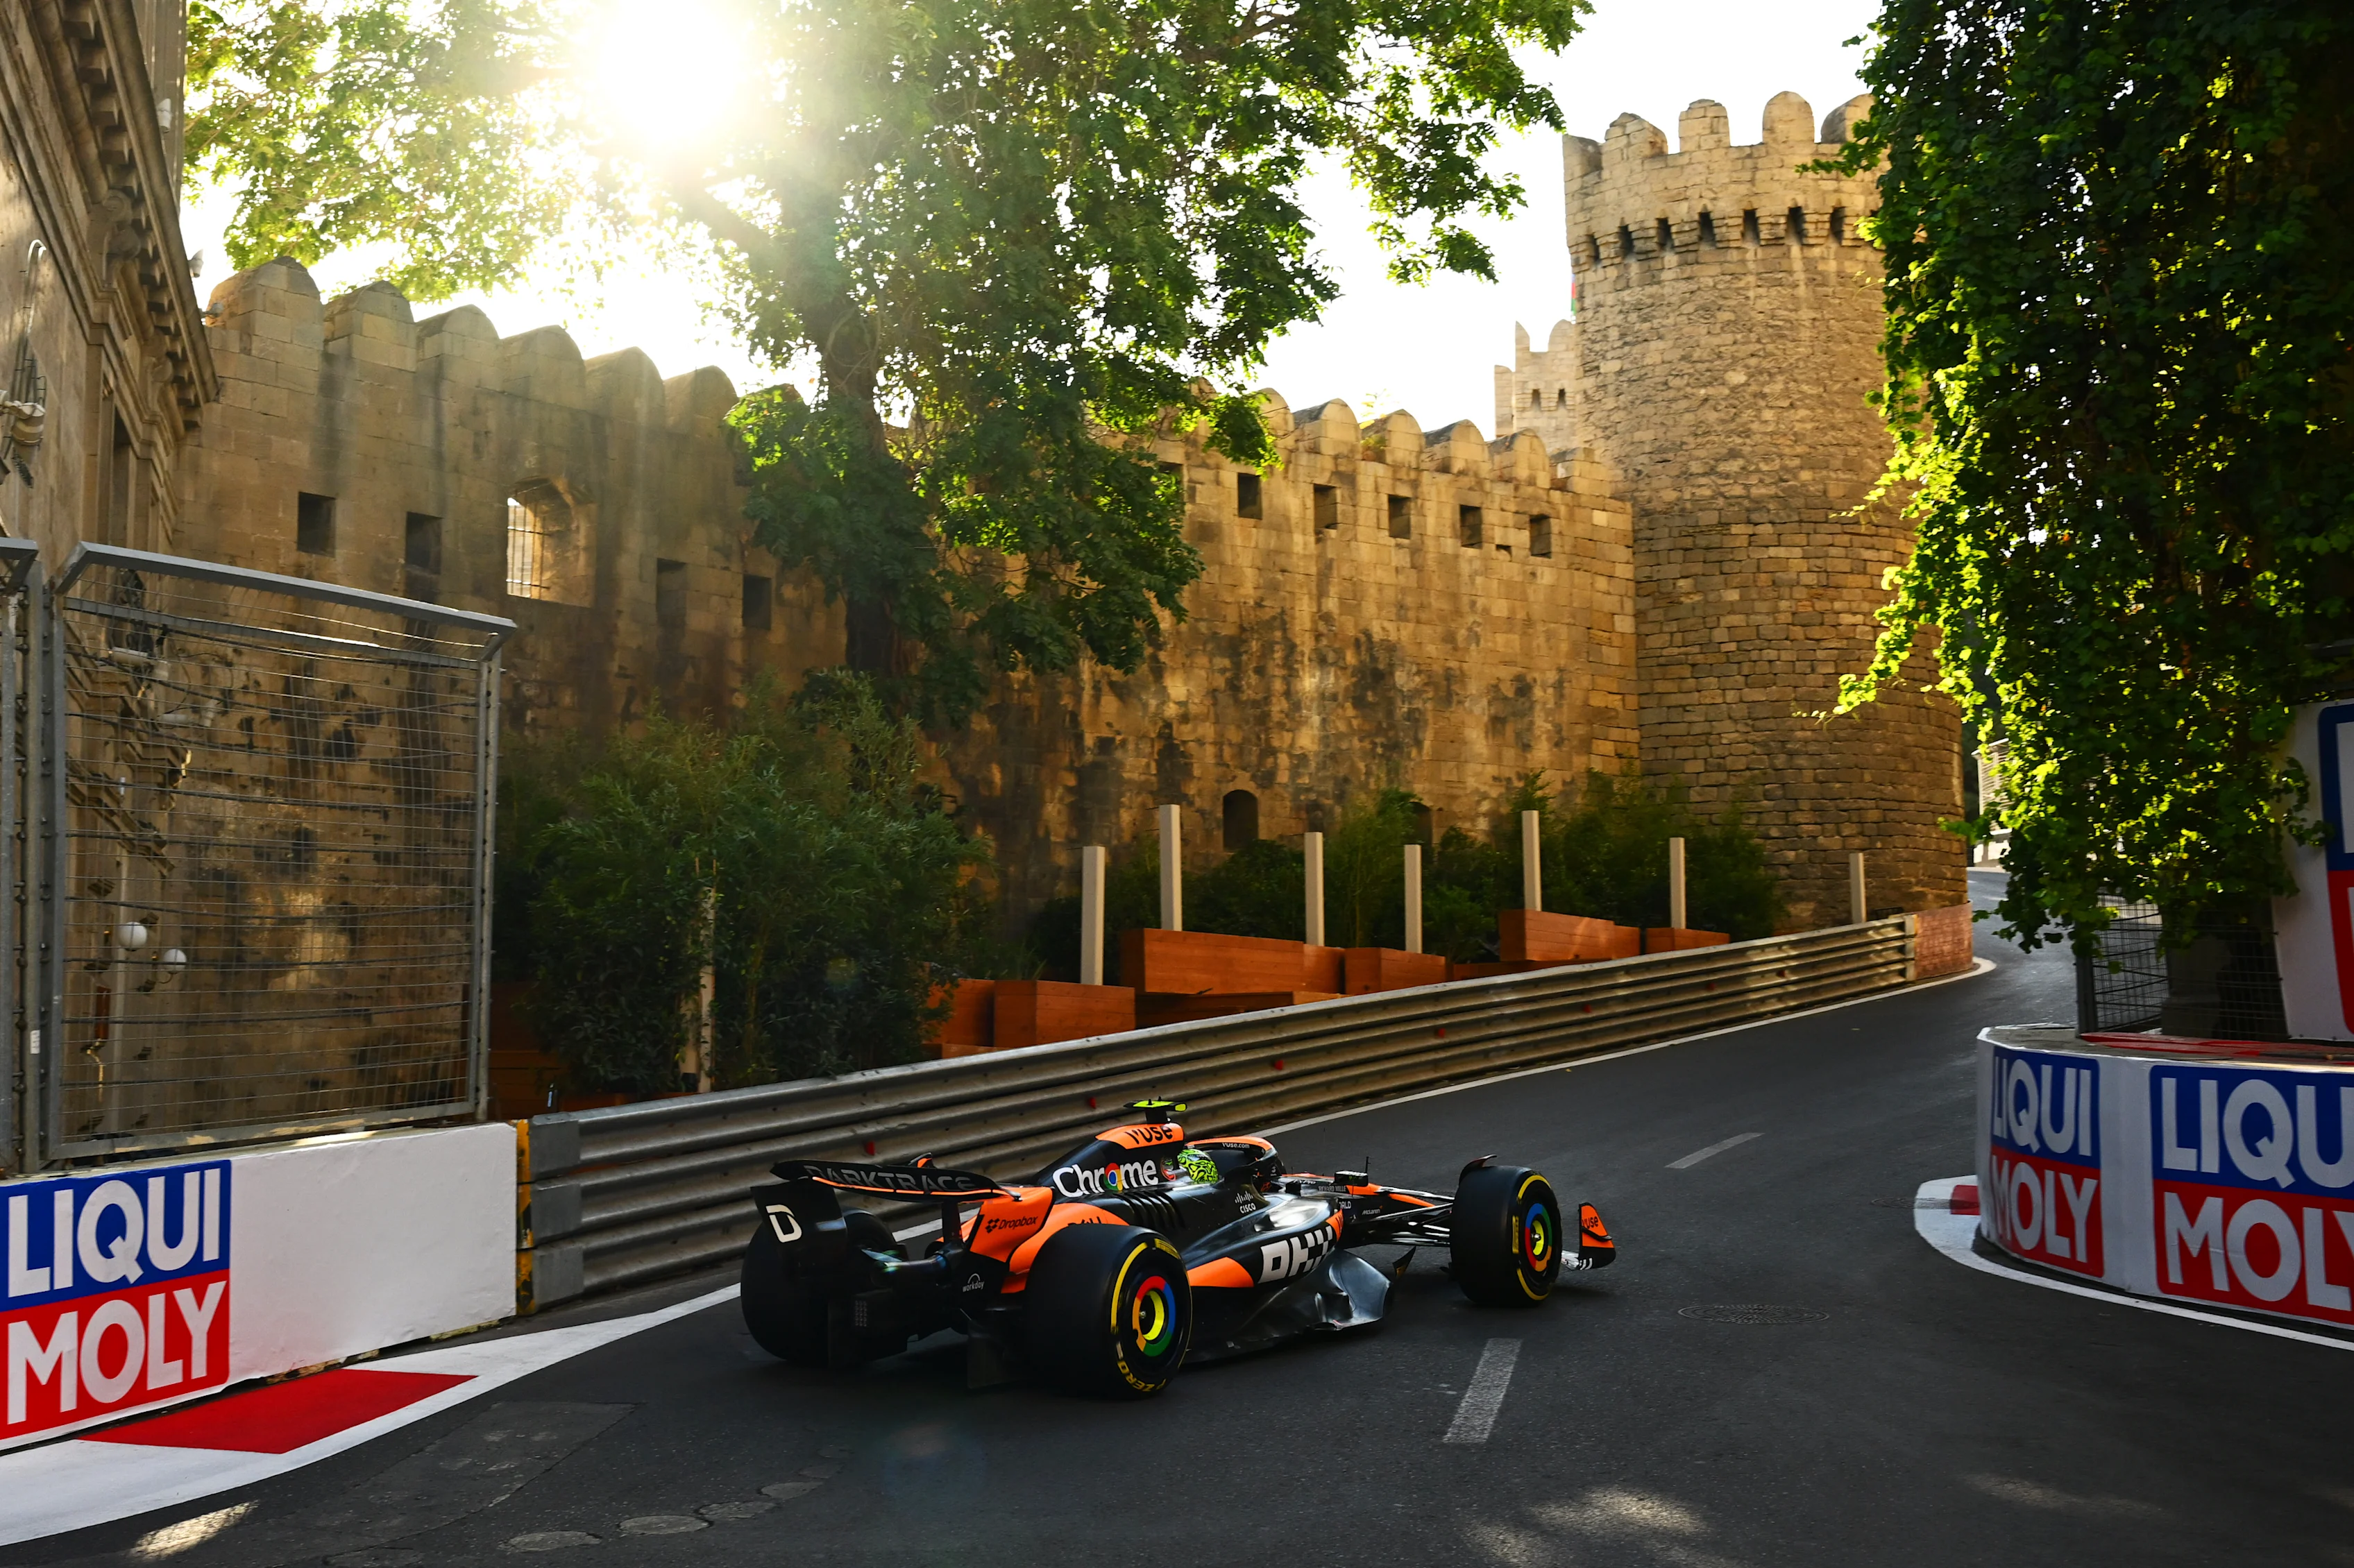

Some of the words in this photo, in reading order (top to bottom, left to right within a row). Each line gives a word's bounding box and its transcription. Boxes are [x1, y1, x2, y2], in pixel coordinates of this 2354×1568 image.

[1993, 1056, 2092, 1157] LIQUI
[2161, 1077, 2354, 1189] LIQU
[804, 1165, 975, 1193] DARKTRACE
[1053, 1159, 1159, 1198] Chrome
[1992, 1154, 2099, 1263] MOLY
[8, 1168, 221, 1297] LIQUI
[998, 1216, 1039, 1231] Dropbox
[962, 1280, 985, 1293] workday
[7, 1280, 227, 1425] MOLY
[1117, 1360, 1155, 1392] ZERO
